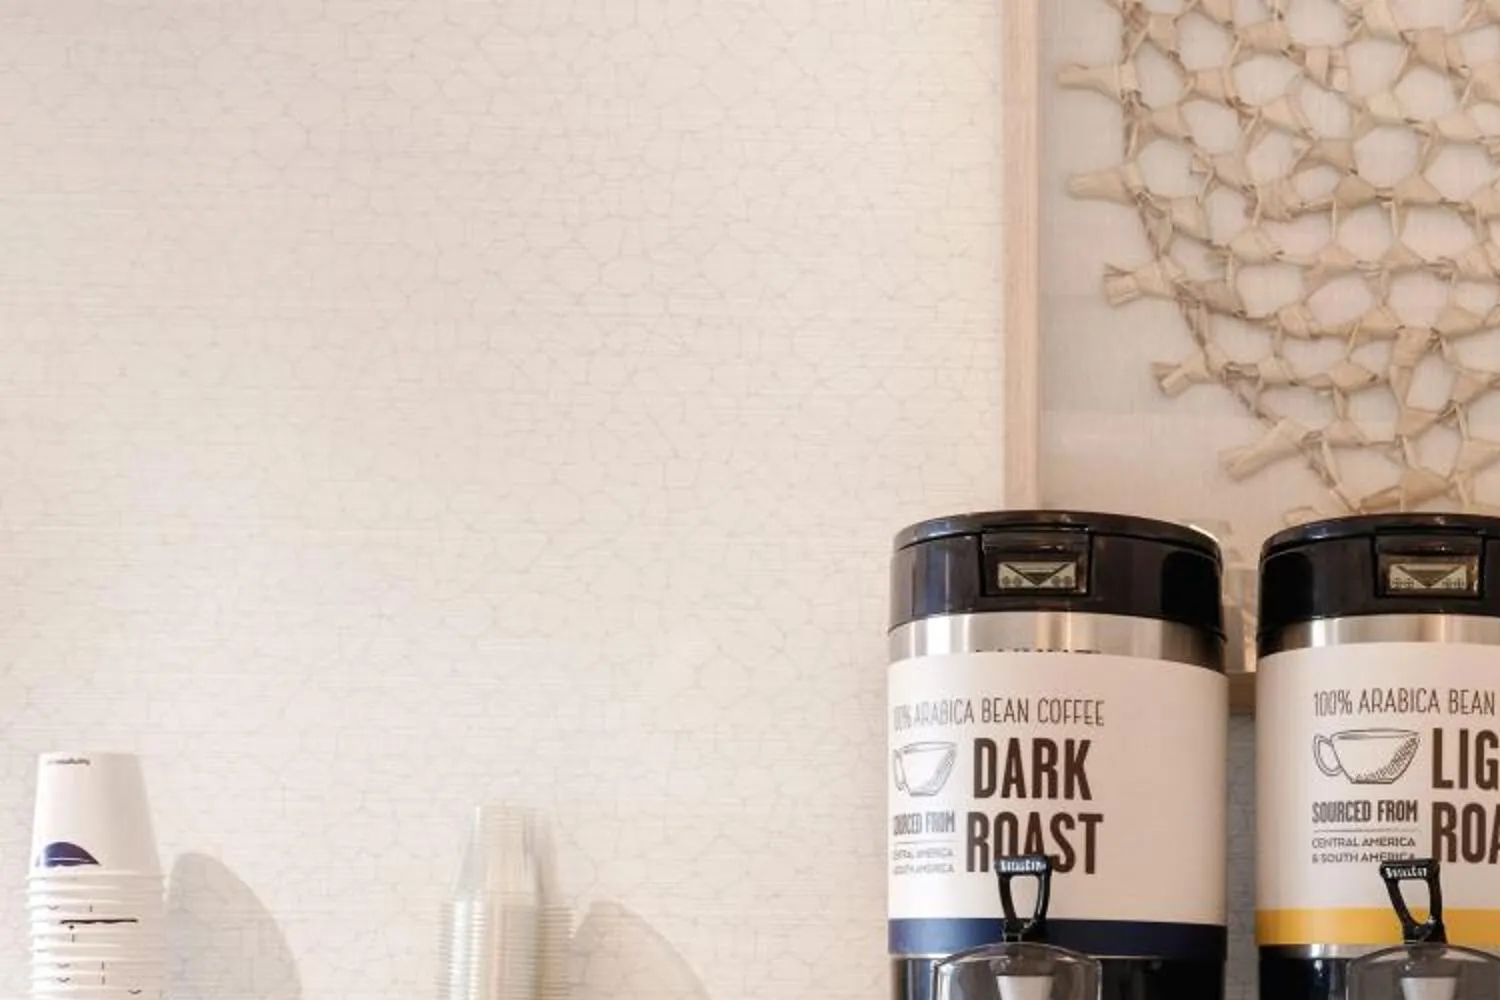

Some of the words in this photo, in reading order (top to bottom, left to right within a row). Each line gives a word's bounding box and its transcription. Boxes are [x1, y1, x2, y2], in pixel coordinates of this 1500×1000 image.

[982, 698, 1030, 724] BEAN
[1037, 698, 1105, 727] COFFEE
[1313, 689, 1353, 717] 100%
[1358, 687, 1441, 715] ARABICA
[1450, 689, 1495, 716] BEAN
[973, 737, 1092, 800] DARK
[1311, 800, 1372, 823] SOURCED
[1377, 799, 1419, 822] FROM
[966, 811, 1105, 875] ROAST
[1312, 837, 1360, 849] CENTRAL
[1362, 836, 1416, 847] AMERICA
[1320, 853, 1359, 863] SOUTH
